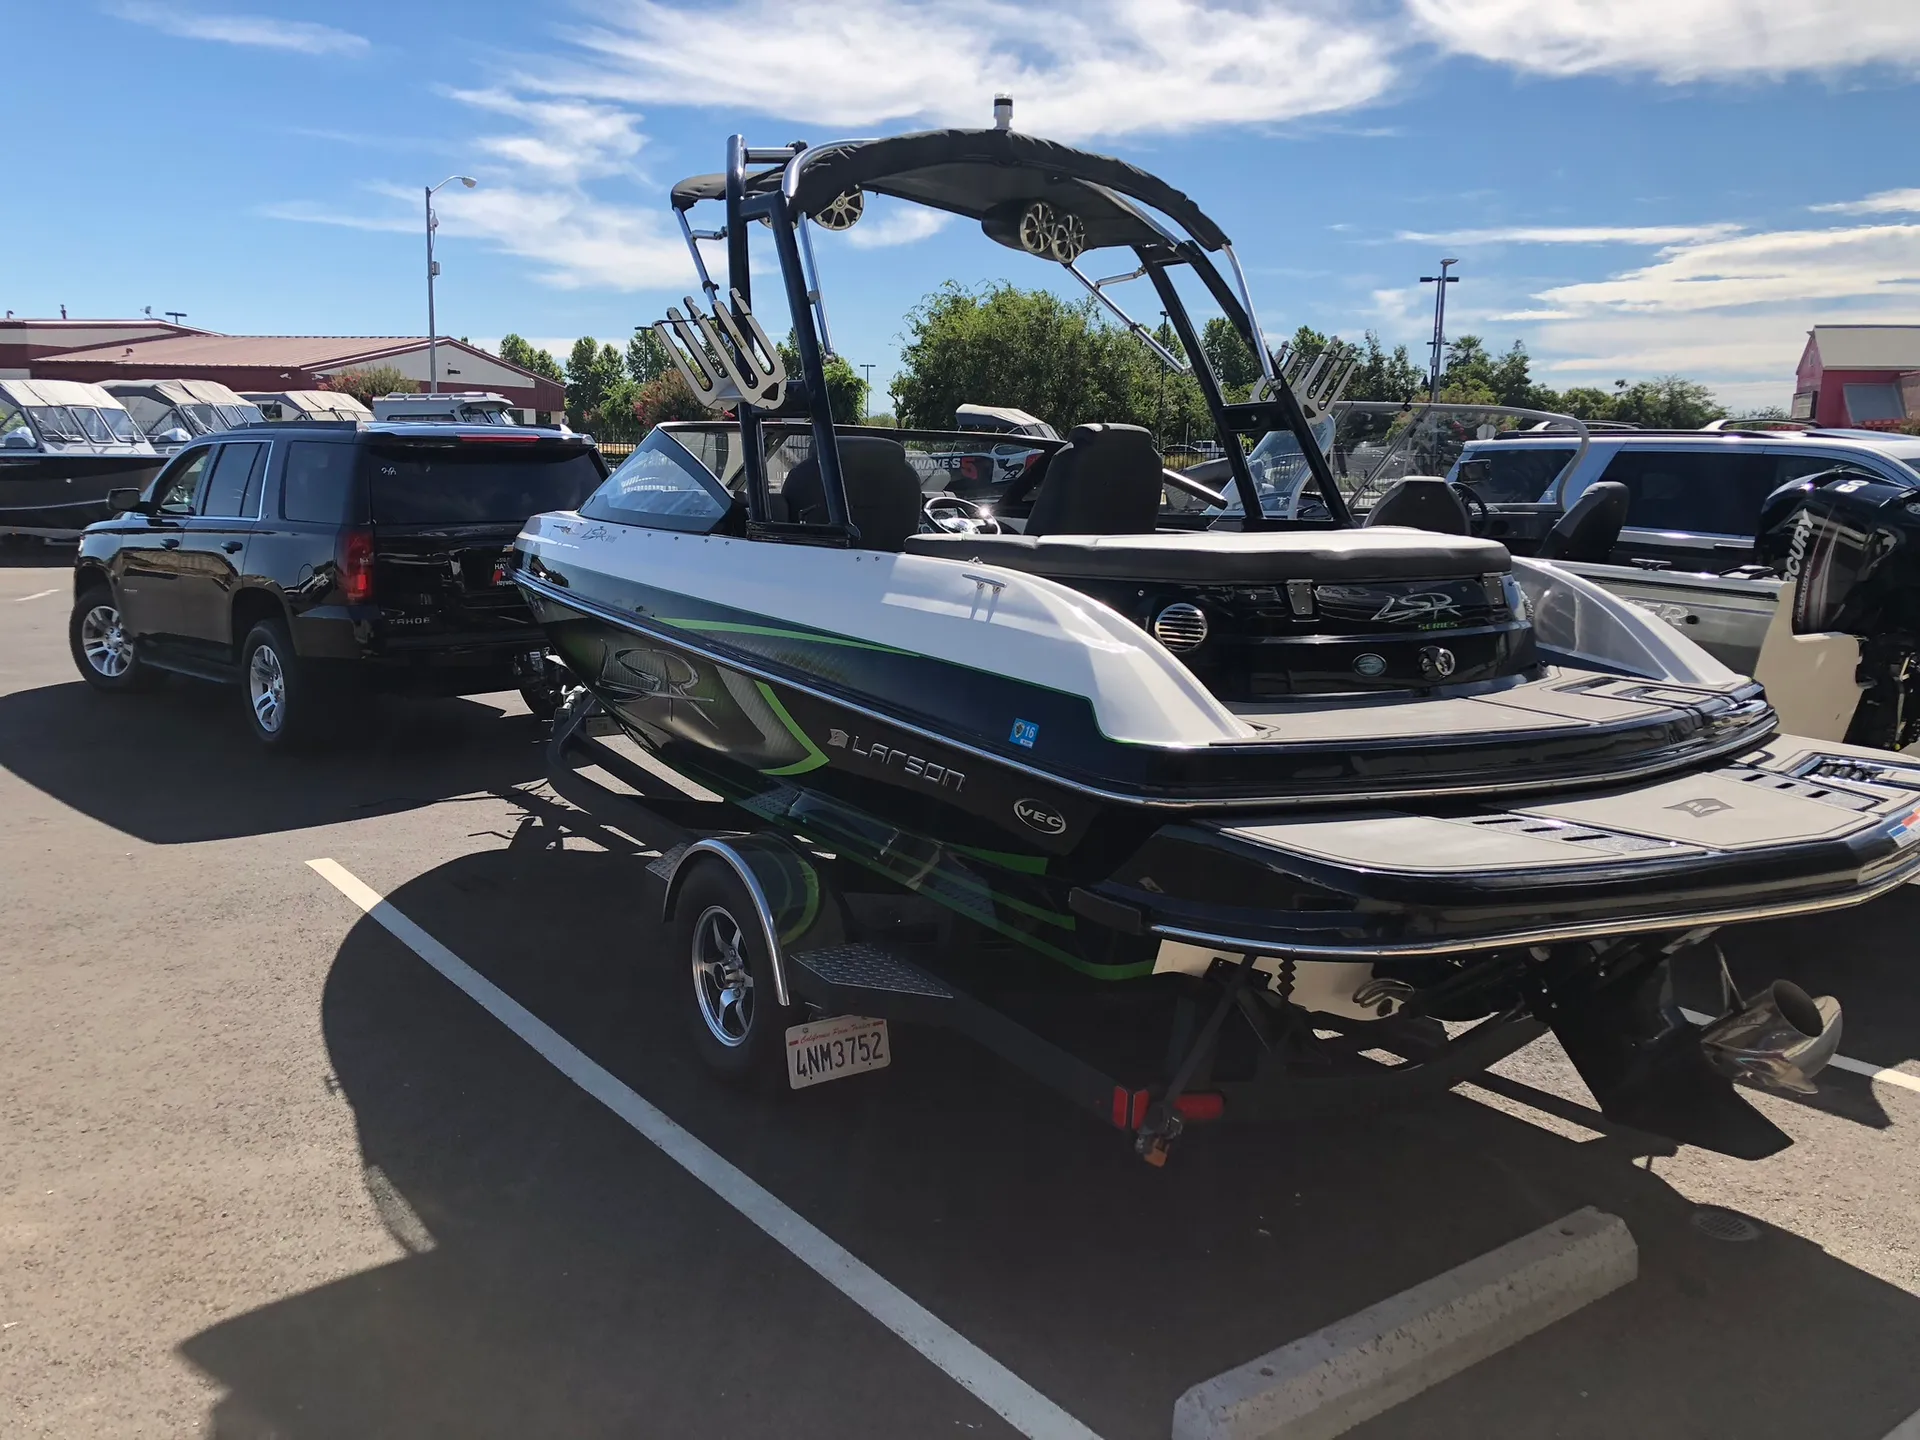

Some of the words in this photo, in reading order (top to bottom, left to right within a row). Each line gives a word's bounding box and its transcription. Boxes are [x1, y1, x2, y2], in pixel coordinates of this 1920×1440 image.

[1835, 480, 1871, 493] 60
[388, 616, 430, 625] TAHOE
[1024, 725, 1036, 739] 16
[1018, 804, 1062, 828] VEC
[796, 1031, 884, 1077] 4NM3752
